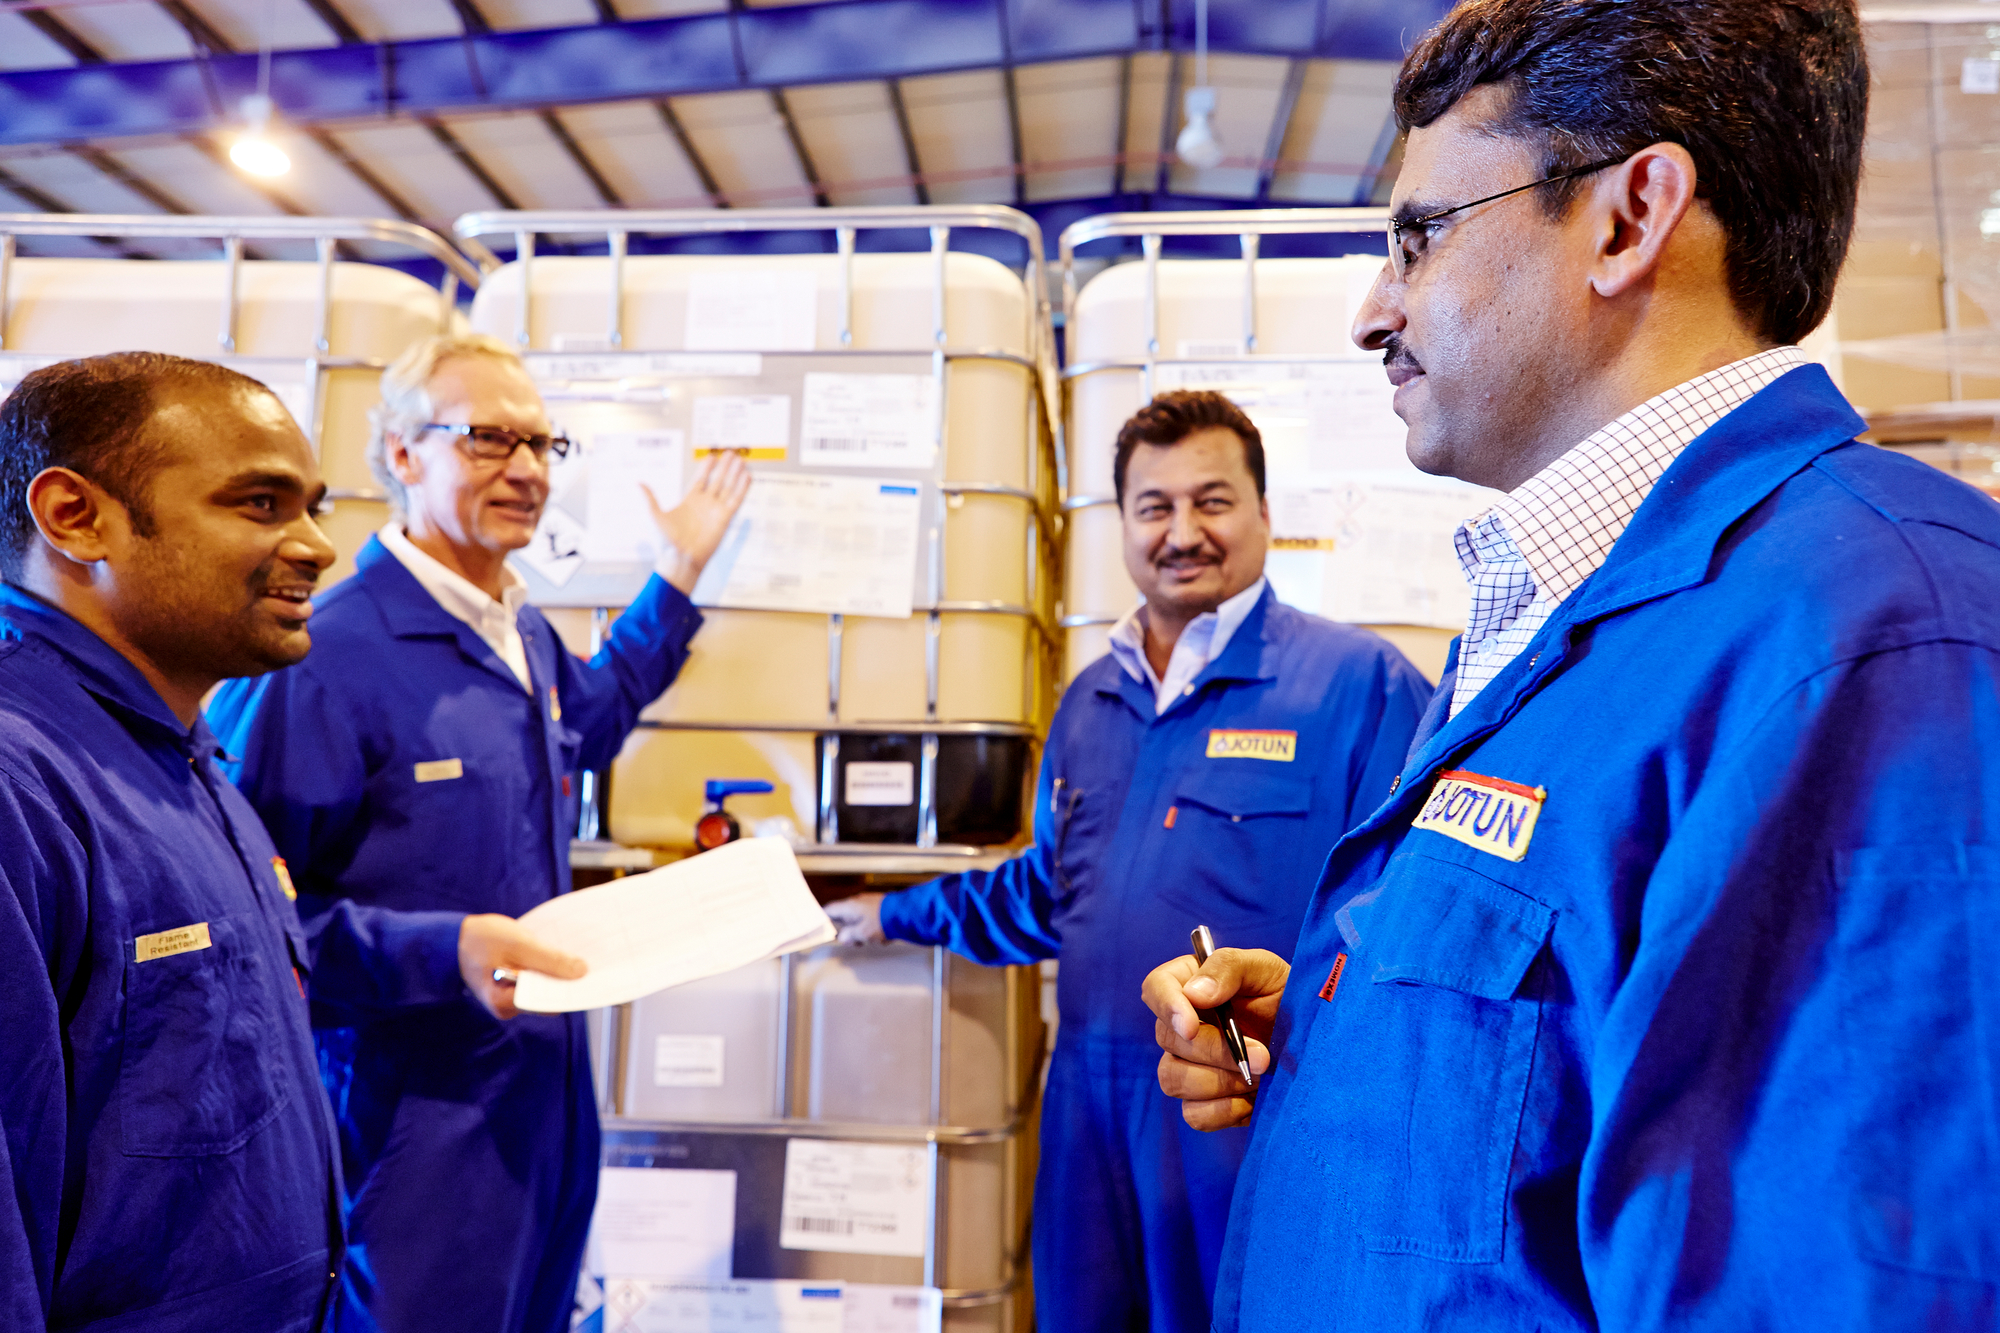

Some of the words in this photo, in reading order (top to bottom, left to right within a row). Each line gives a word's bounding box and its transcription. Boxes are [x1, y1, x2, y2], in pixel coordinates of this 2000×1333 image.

[1231, 738, 1289, 754] JOTUN
[1433, 785, 1529, 848] JOTUN
[151, 938, 198, 955] Resistant
[159, 932, 189, 945] Flame
